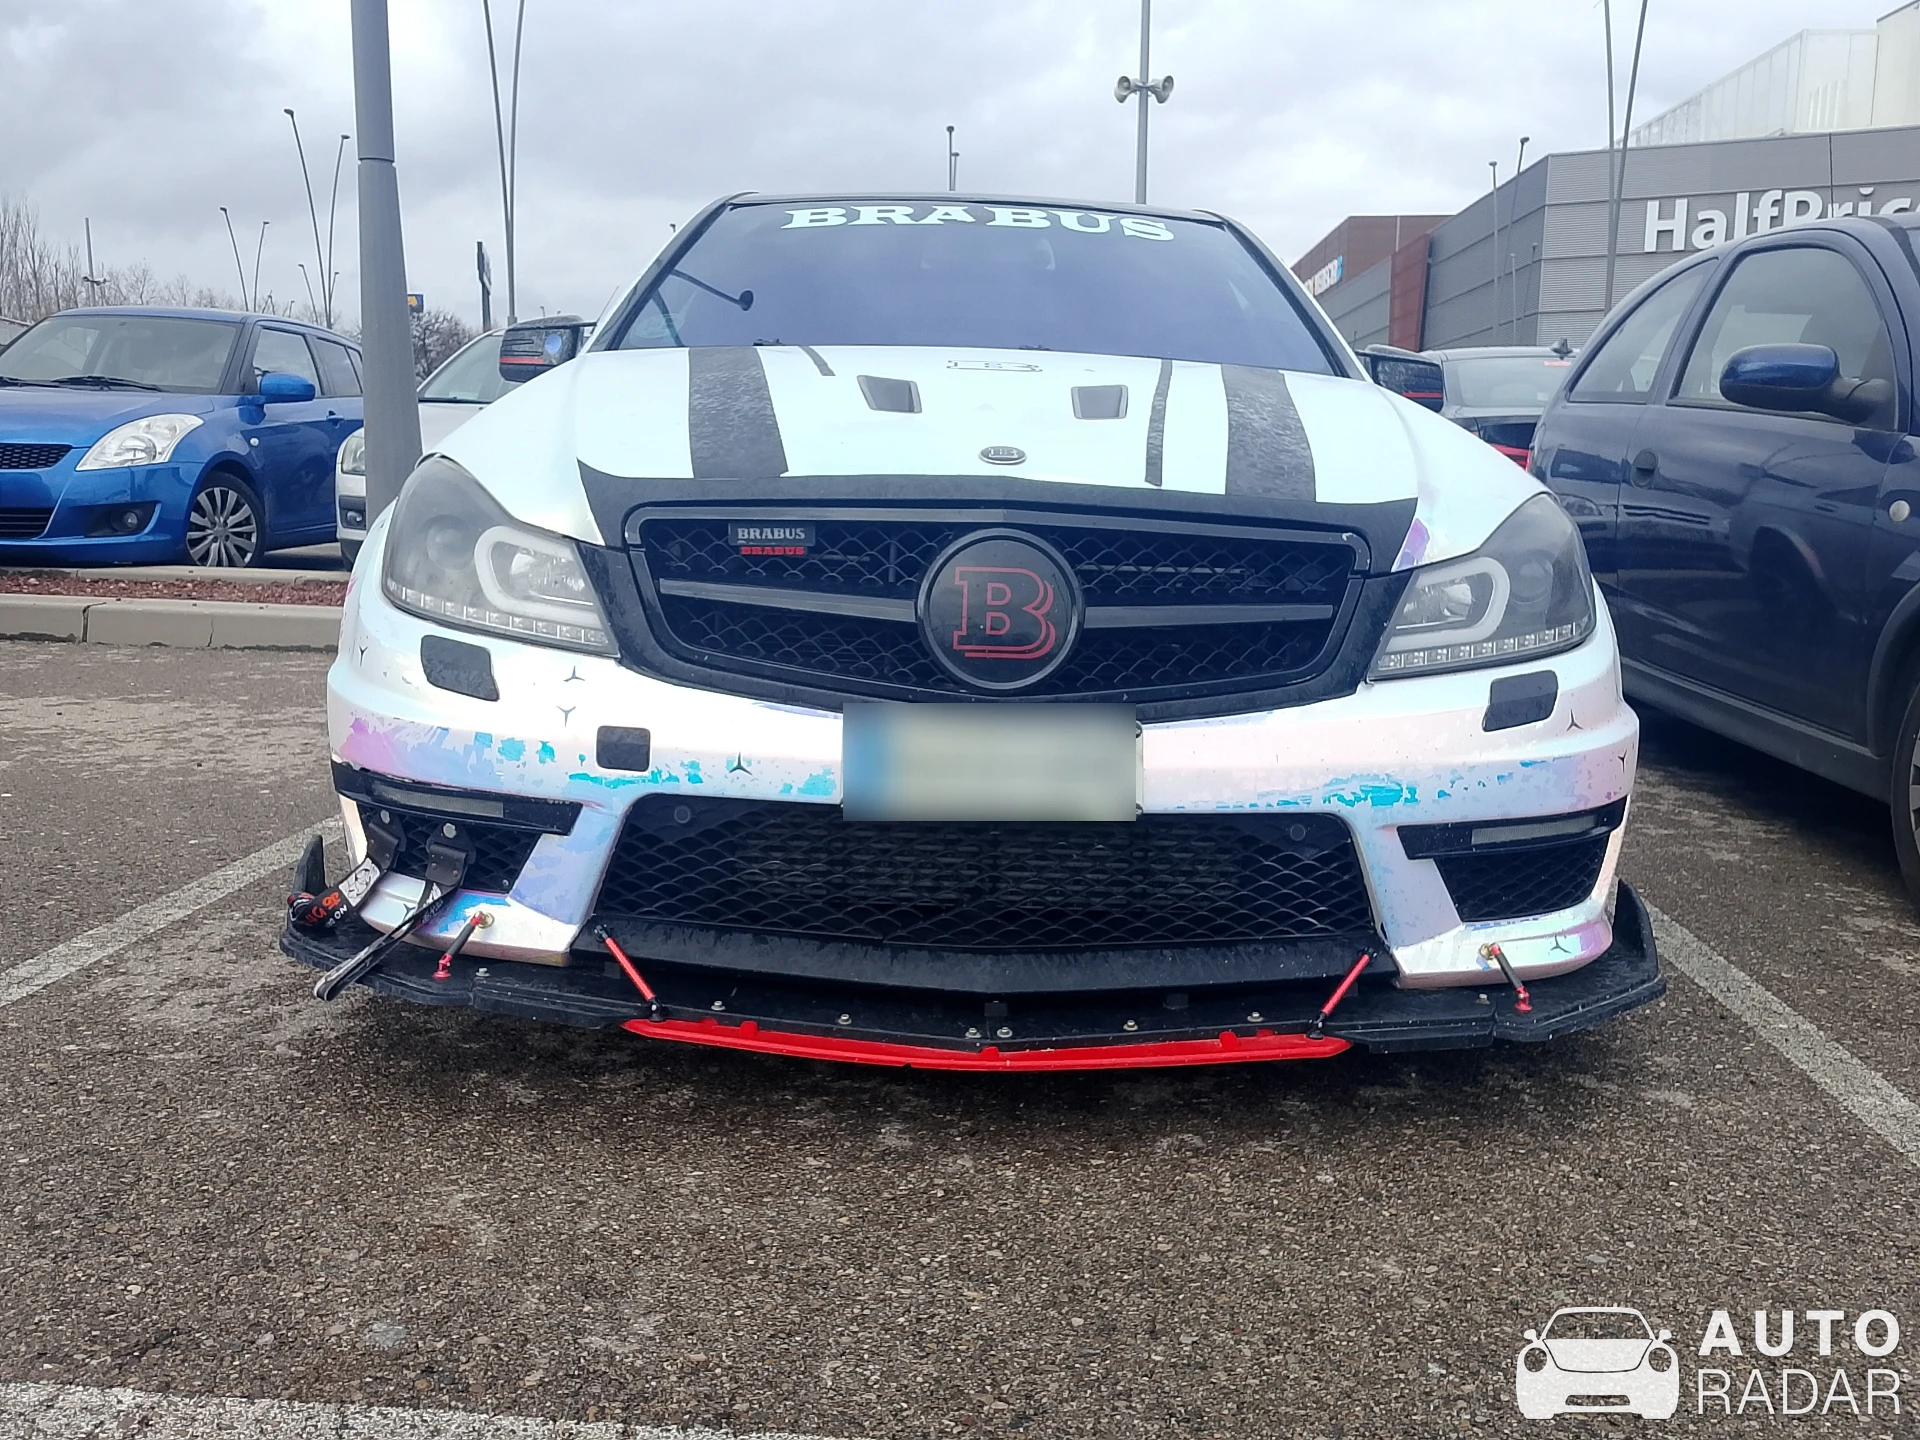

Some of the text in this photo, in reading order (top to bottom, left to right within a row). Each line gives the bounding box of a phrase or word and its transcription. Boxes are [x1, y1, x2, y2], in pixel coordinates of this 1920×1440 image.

[781, 205, 1175, 242] BRABUS
[1644, 187, 1920, 253] HalfPri
[737, 527, 806, 540] BRABUS
[741, 546, 805, 556] BRABUS
[953, 566, 1056, 660] B
